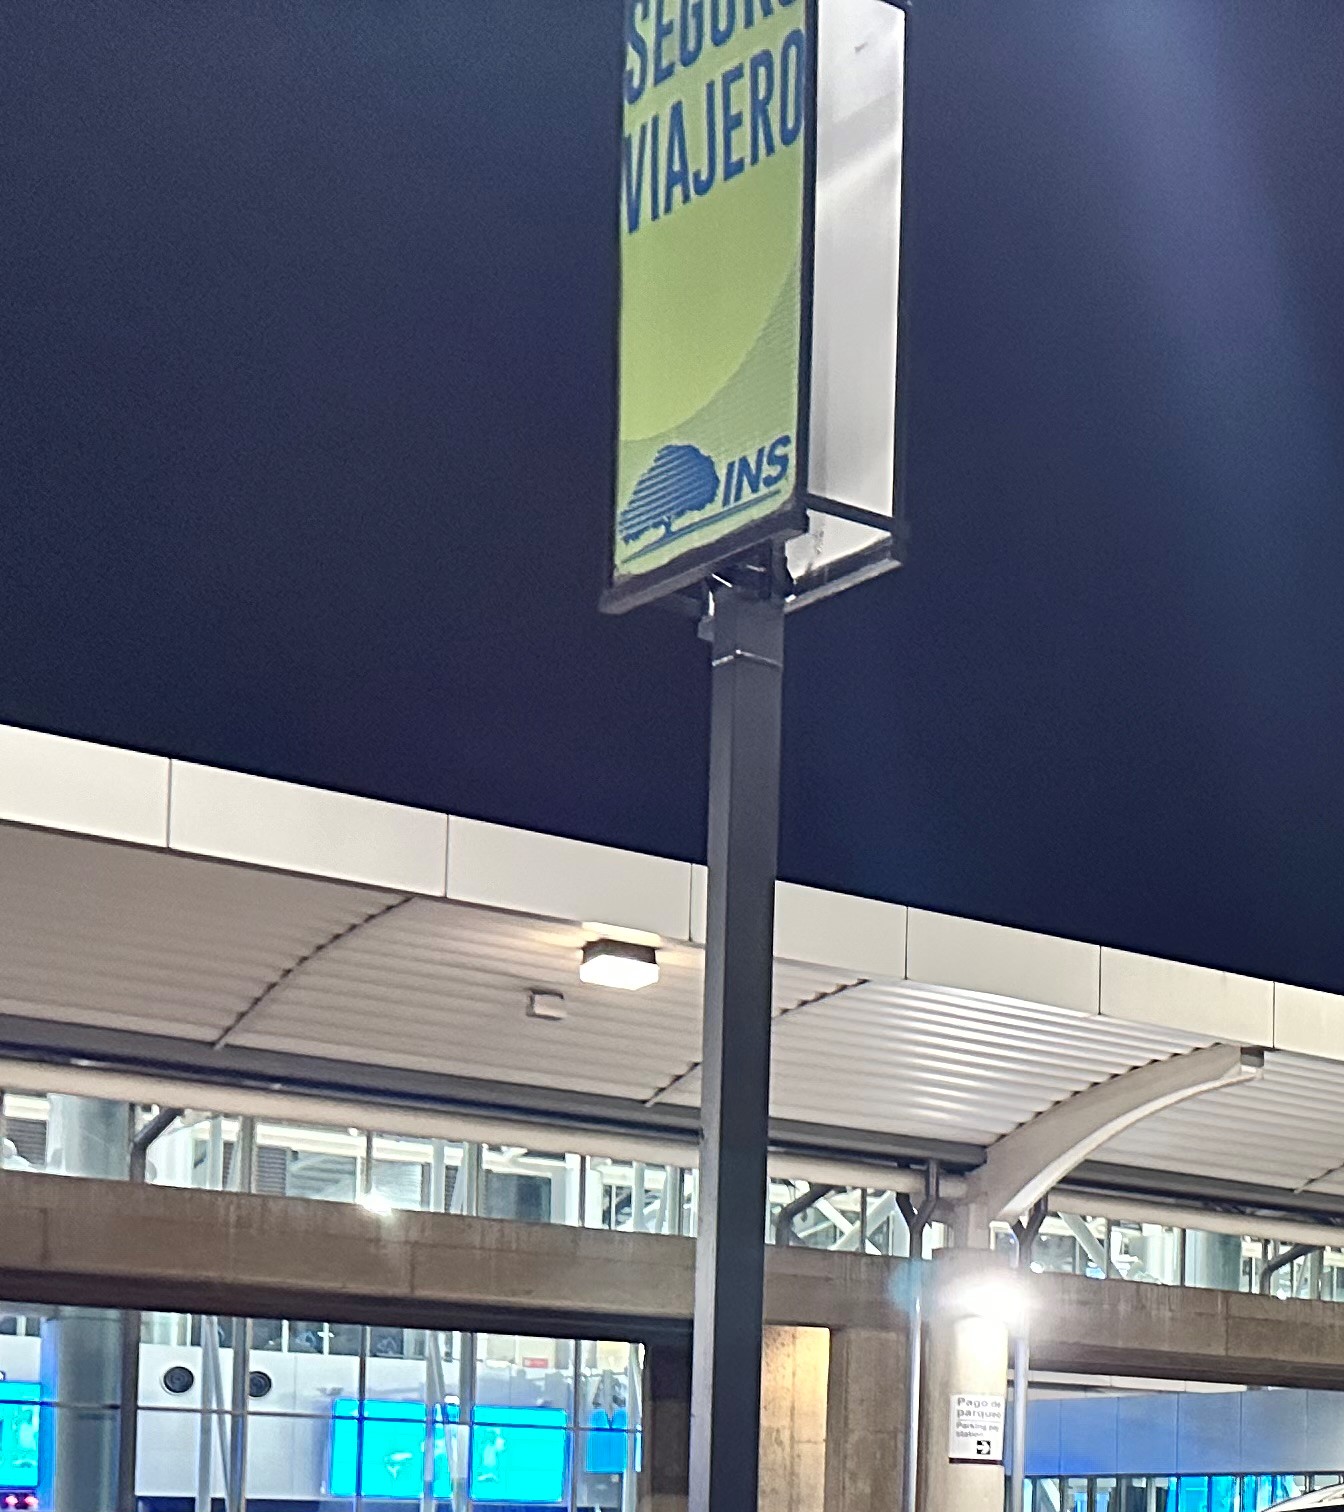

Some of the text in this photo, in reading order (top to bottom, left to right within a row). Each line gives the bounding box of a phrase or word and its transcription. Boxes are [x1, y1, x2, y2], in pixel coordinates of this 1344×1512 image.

[624, 28, 806, 233] VIAJERO
[722, 435, 791, 507] INS
[957, 1397, 988, 1408] Pago
